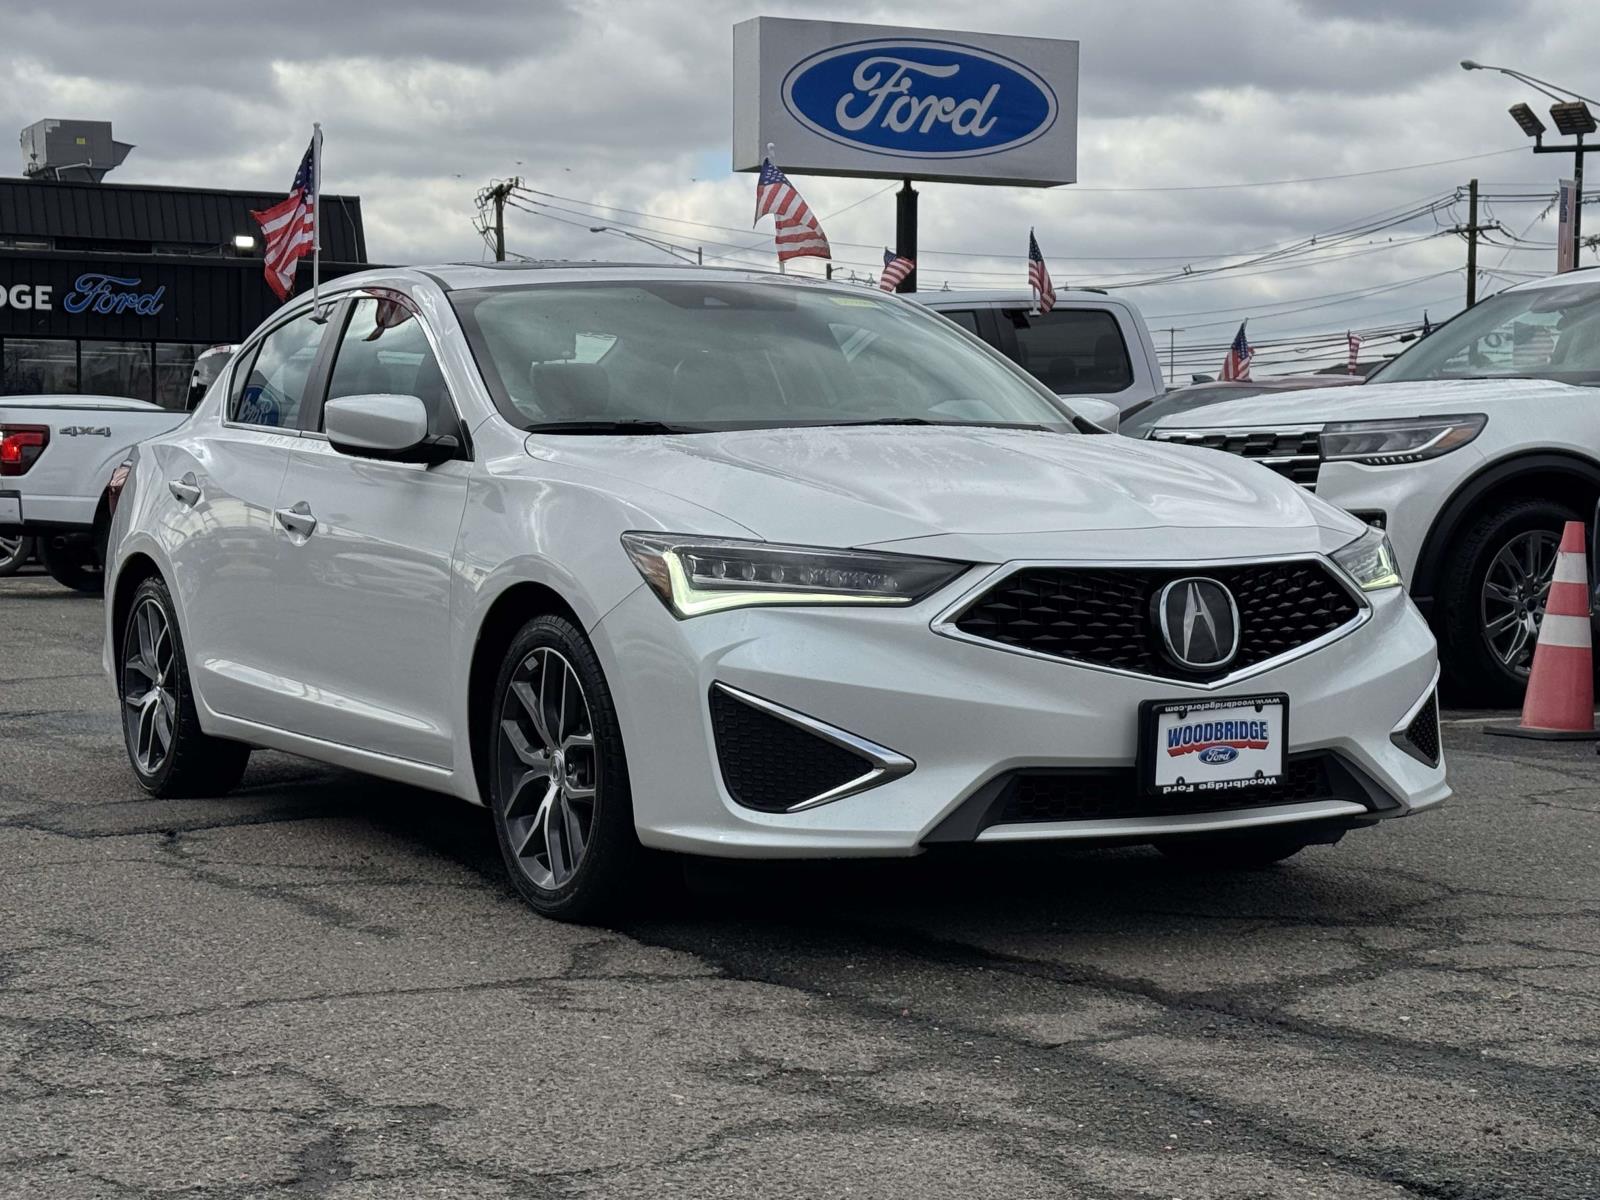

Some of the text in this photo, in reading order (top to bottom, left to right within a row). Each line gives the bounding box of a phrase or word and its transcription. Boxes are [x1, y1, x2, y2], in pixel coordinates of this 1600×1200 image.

[836, 56, 1001, 138] Ford
[64, 273, 166, 315] Ford
[1165, 698, 1281, 712] www.woodbridgeford.com
[1167, 719, 1269, 748] WOODBRIDGE
[1206, 748, 1231, 762] Ford
[1162, 777, 1277, 795] Woodbridge Ford
